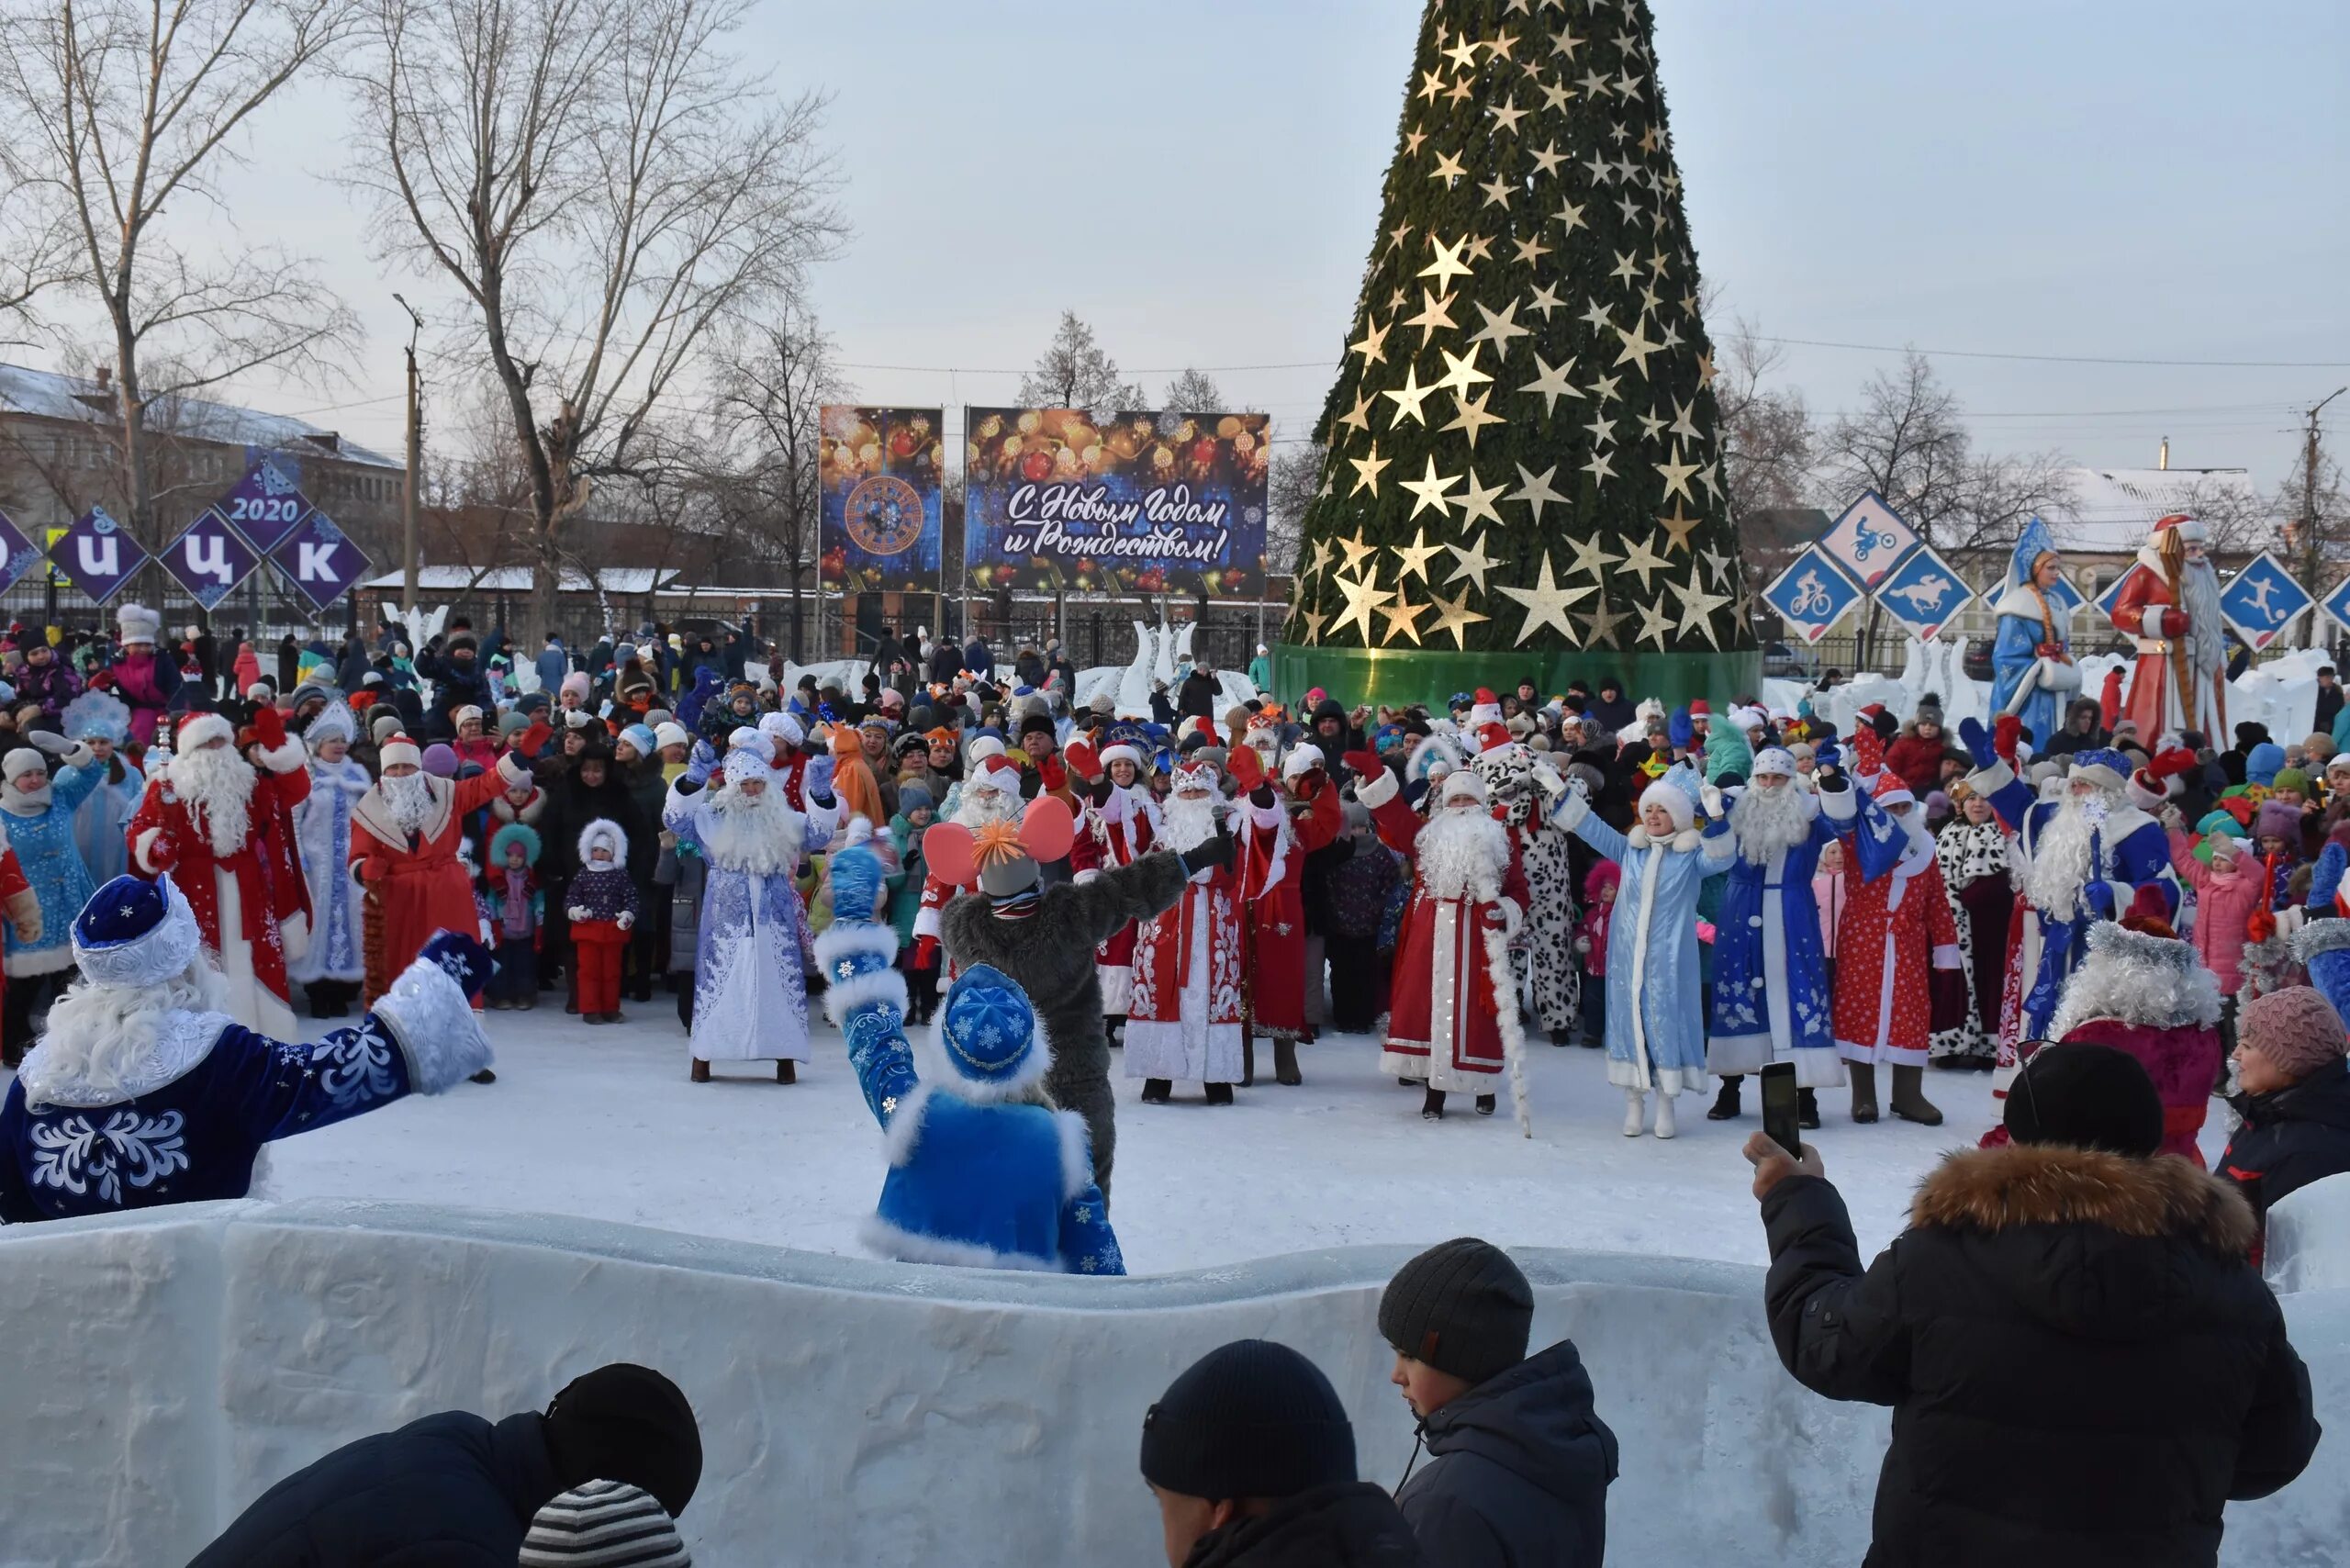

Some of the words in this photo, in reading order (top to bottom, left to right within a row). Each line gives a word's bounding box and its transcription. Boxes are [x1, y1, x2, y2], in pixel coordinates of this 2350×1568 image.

[230, 498, 297, 521] 2020
[1009, 485, 1035, 519] С
[1041, 485, 1139, 524] Новым
[1145, 485, 1225, 527] Годом
[1014, 519, 1227, 562] Рождеством!
